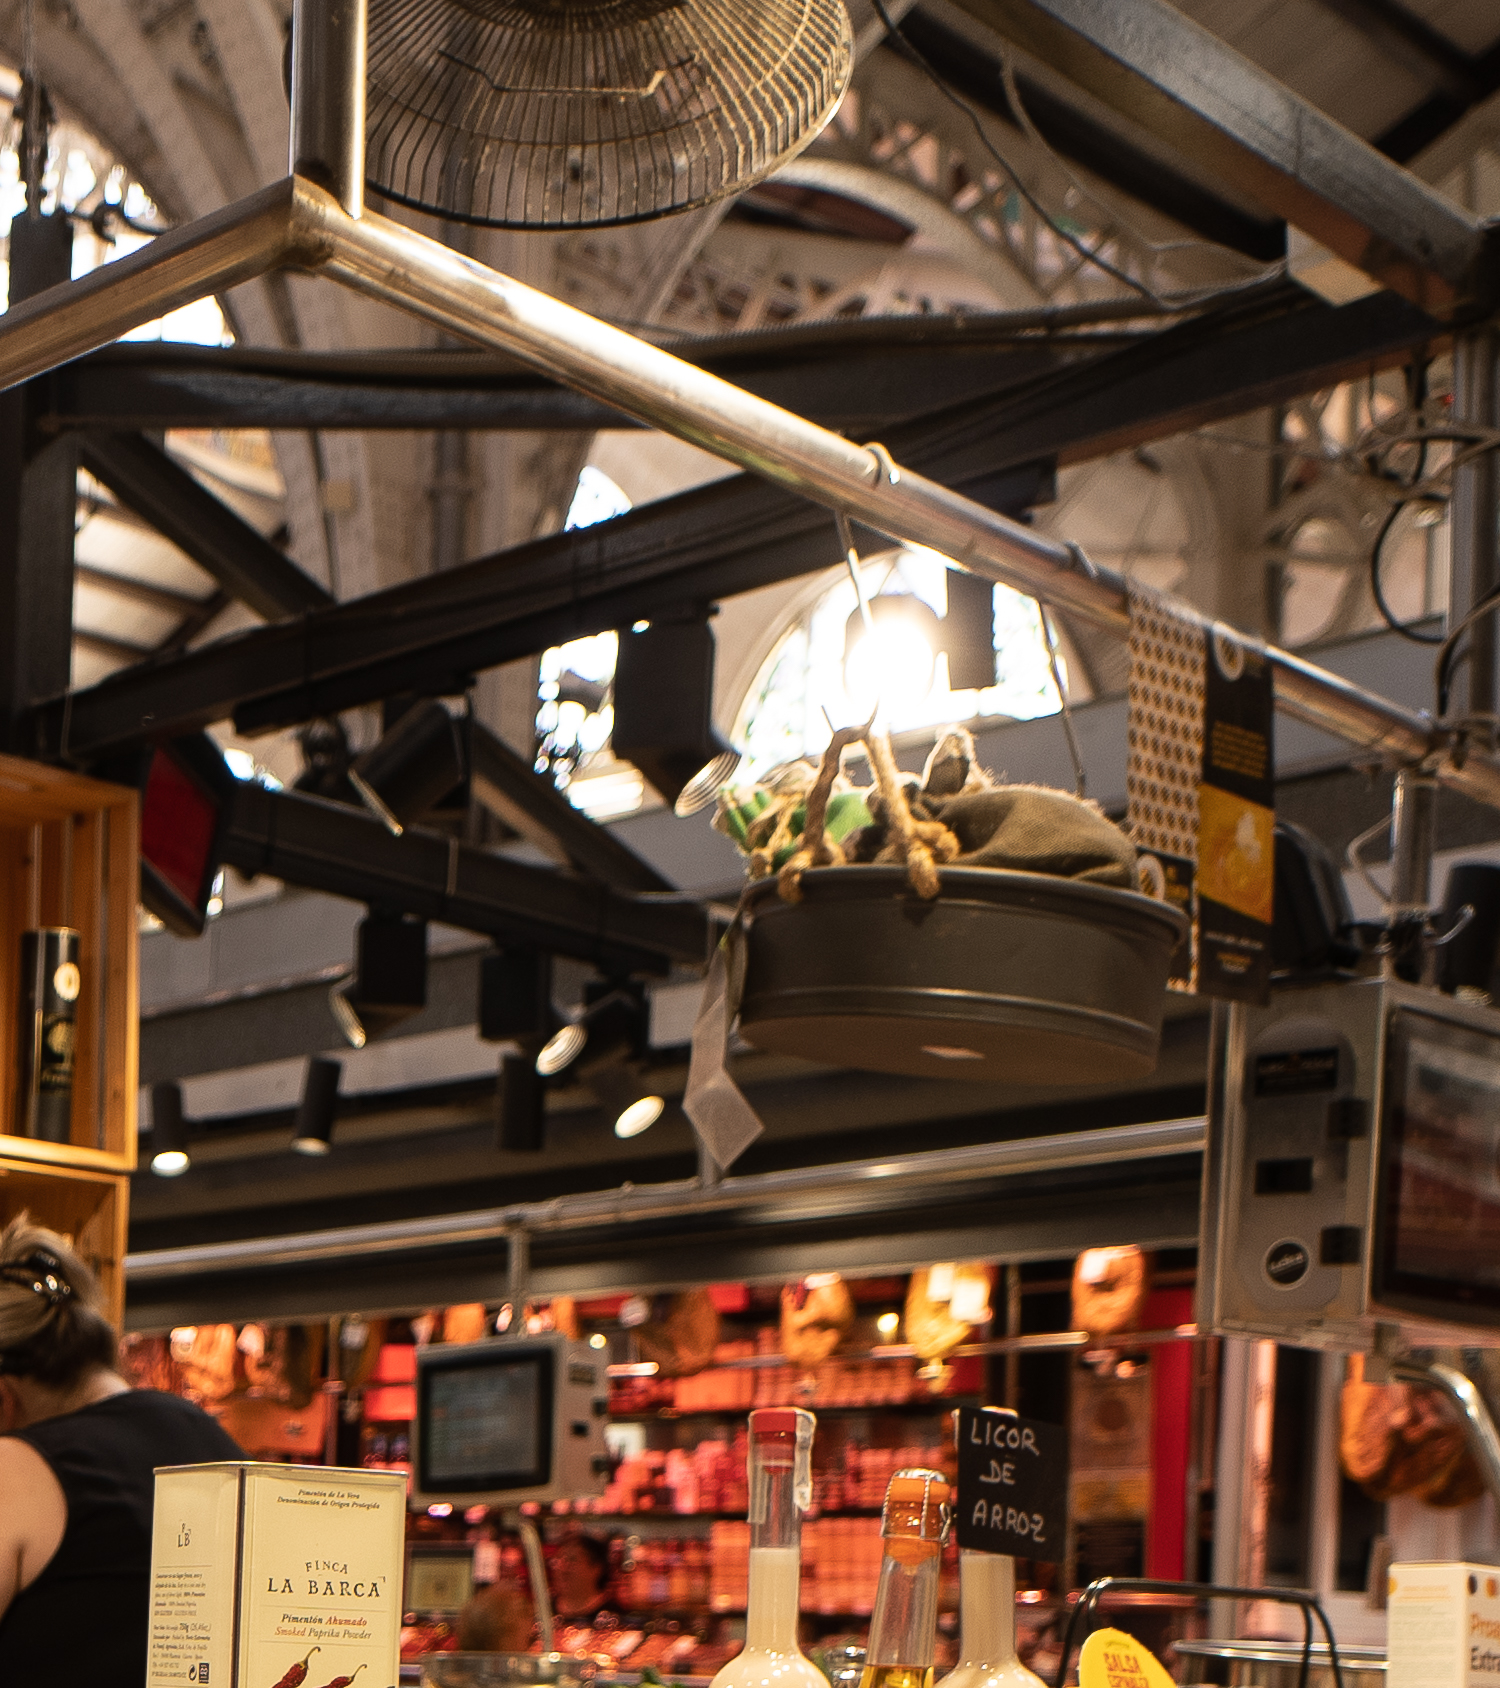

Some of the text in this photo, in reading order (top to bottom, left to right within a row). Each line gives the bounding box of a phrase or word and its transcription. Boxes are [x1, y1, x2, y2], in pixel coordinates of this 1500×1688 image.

[970, 1419, 1040, 1457] LICOR
[979, 1462, 1016, 1487] DE
[971, 1504, 1049, 1544] ARROZ
[305, 1560, 348, 1575] FINCA
[267, 1577, 380, 1598] LA BARCA
[281, 1613, 367, 1626] Pimentón Ahumado
[275, 1626, 372, 1641] Smoked Paprika Powder
[1103, 1652, 1141, 1674] SALSA
